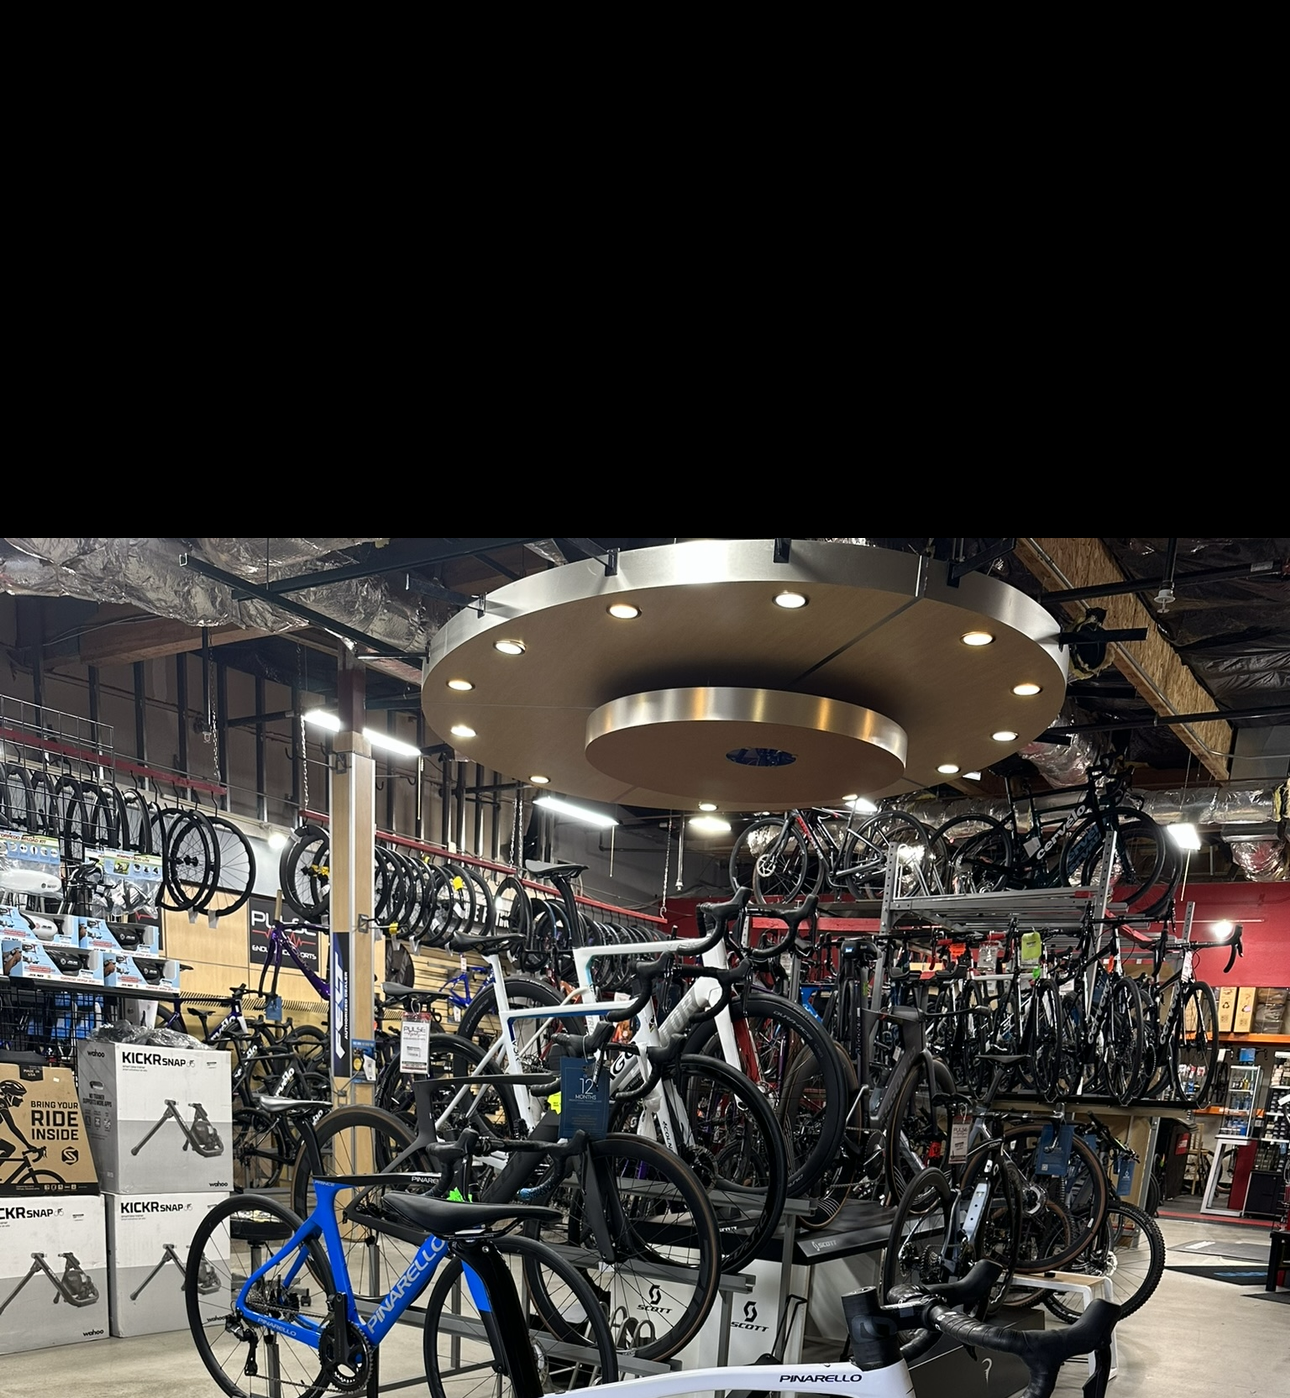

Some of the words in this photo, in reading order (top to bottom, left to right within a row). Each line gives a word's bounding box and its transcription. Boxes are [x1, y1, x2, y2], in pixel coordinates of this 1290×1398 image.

[335, 952, 345, 1059] FELT
[87, 1049, 105, 1058] wahoo
[122, 1051, 162, 1066] KICKR
[162, 1058, 187, 1067] SNAP
[579, 1077, 594, 1095] 12
[31, 1100, 56, 1109] BRING
[58, 1101, 78, 1109] YOUR
[31, 1110, 79, 1127] RIDE
[31, 1128, 79, 1140] INSIDE
[121, 1201, 159, 1213] KICKR
[160, 1203, 183, 1212] SNAP
[0, 1207, 25, 1220] CKR
[27, 1209, 54, 1218] SNAP
[367, 1236, 445, 1334] PINARELLO
[637, 1304, 672, 1314] SCOTT
[83, 1328, 104, 1337] wahoo
[257, 1318, 297, 1337] PINARELLO
[730, 1321, 769, 1332] SCOTT
[779, 1374, 863, 1383] PINARELLO
